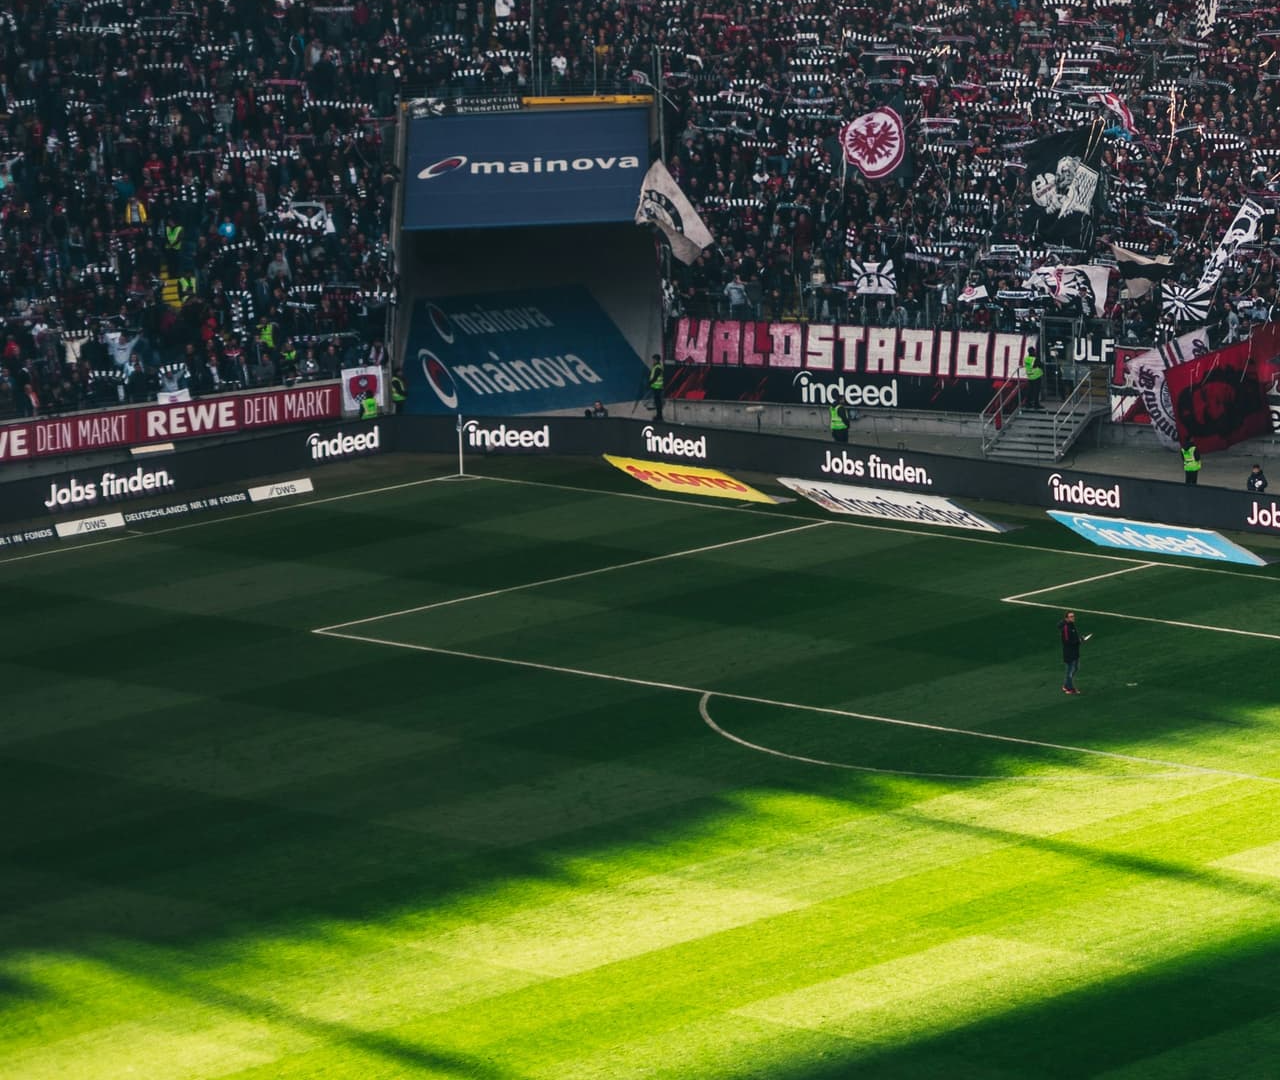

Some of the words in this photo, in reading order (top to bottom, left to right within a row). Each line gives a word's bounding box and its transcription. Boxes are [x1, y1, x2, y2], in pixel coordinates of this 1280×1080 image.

[470, 155, 640, 175] mainova
[673, 318, 1040, 381] WALDSTADION
[1073, 337, 1115, 363] ULF
[452, 350, 603, 396] mainova
[801, 375, 898, 408] indeed
[147, 401, 236, 438] REWE
[244, 397, 278, 425] DEIN
[283, 389, 333, 419] MARKT
[36, 422, 72, 451] DEIN
[78, 414, 127, 447] MARKT
[310, 425, 380, 461] indeed
[469, 424, 550, 449] indeed
[645, 428, 707, 458] indeed
[821, 450, 865, 477] Jobs
[867, 454, 934, 486] finden.
[45, 478, 97, 510] Jobs
[101, 467, 174, 498] finden.
[1052, 477, 1121, 510] indeed
[124, 503, 189, 522] DEUTSCHLANDS
[209, 497, 218, 507] IN
[219, 492, 247, 506] FONDS
[24, 528, 53, 542] FONDS
